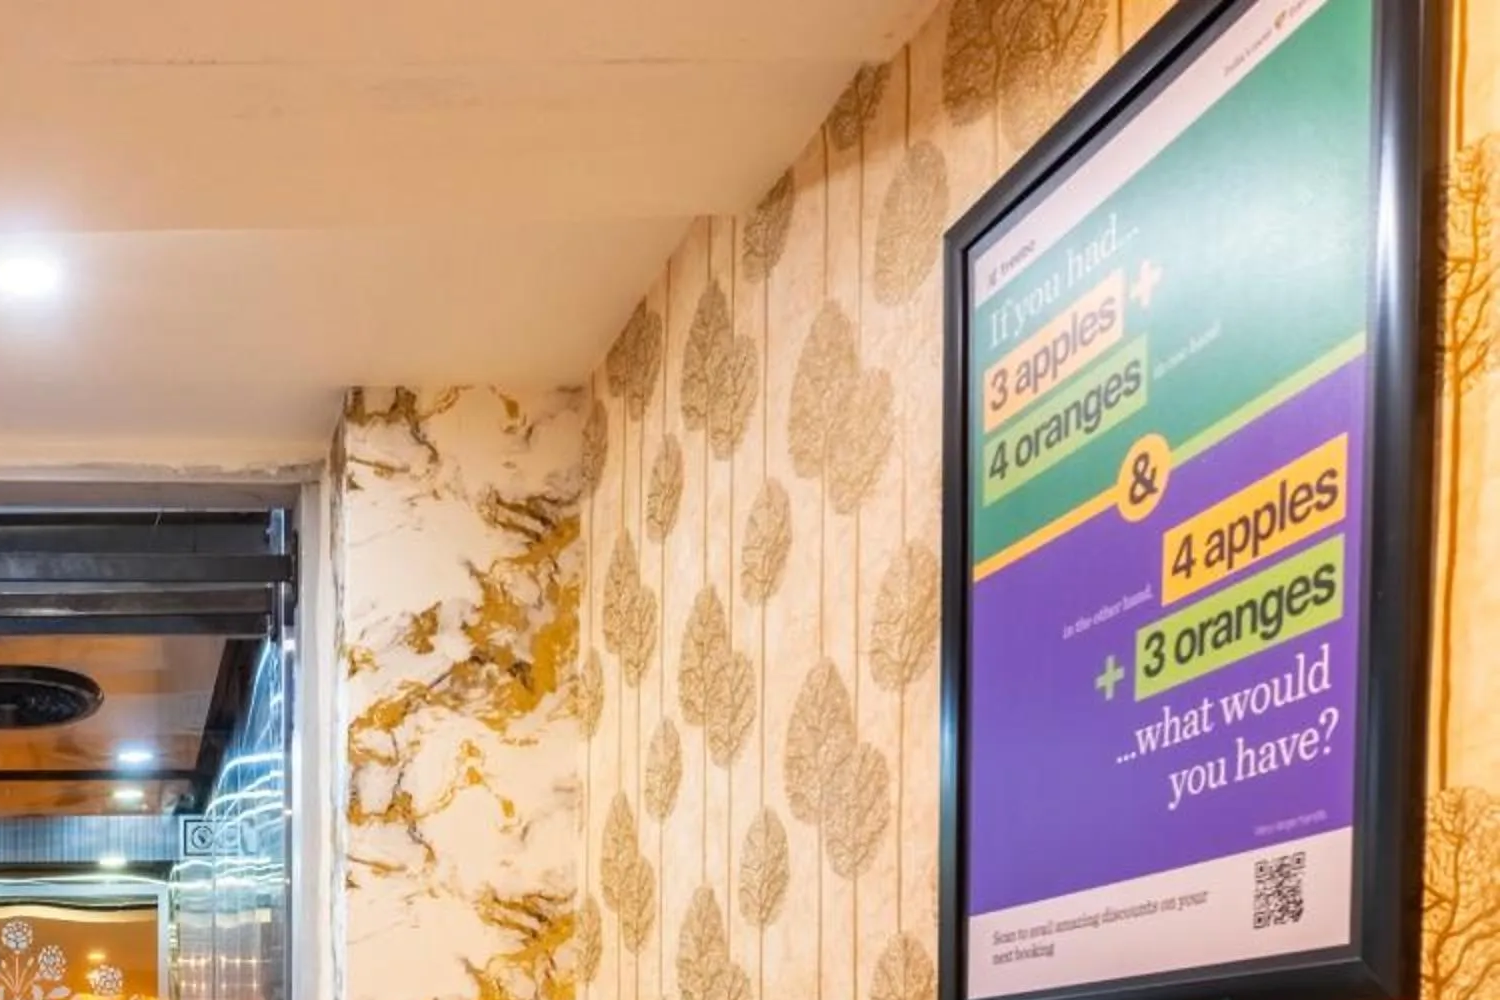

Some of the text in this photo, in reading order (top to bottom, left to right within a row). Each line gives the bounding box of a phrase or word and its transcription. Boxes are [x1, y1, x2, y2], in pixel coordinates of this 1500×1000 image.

[989, 298, 1014, 349] If
[1013, 272, 1060, 338] you
[990, 367, 1009, 412] 3
[1015, 296, 1117, 396] apples
[989, 359, 1142, 480] 4 oranges
[1128, 451, 1159, 506] &
[1171, 467, 1339, 579] 4 apples
[1143, 630, 1166, 678] 3
[1174, 562, 1337, 665] oranges
[1116, 642, 1332, 764] ...what would
[1167, 706, 1340, 811] you have?
[992, 930, 1016, 946] Scan
[1017, 928, 1029, 941] to
[1055, 911, 1101, 934] amazing
[1101, 899, 1158, 924] discounts
[1160, 895, 1177, 912] on
[992, 942, 1056, 966] next booking
